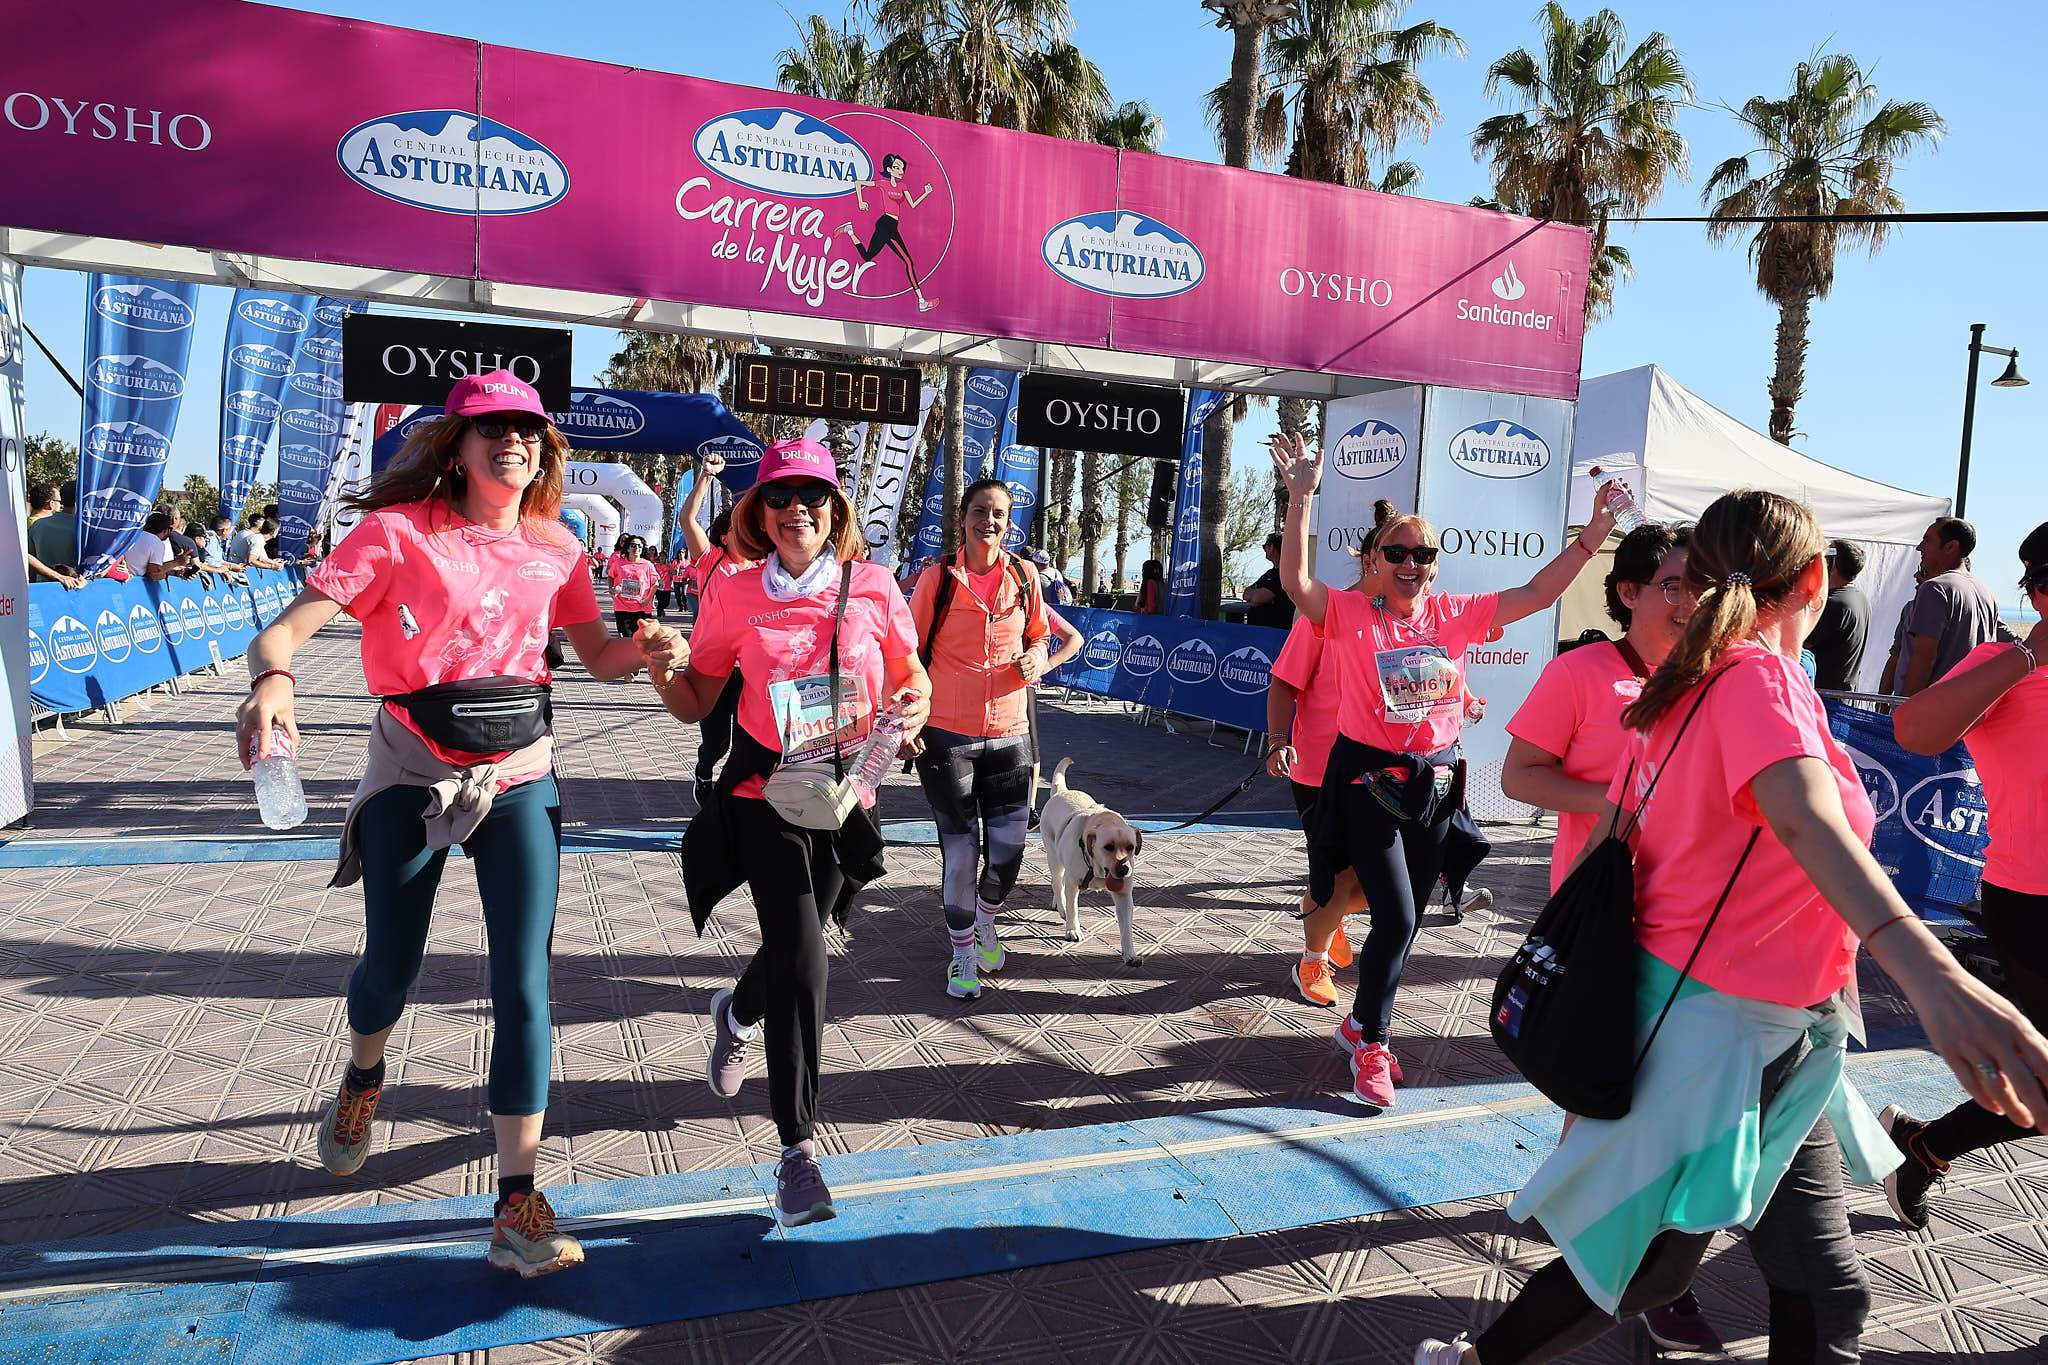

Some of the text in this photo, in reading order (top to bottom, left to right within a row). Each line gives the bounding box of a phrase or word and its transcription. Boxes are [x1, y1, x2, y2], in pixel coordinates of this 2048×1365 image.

[4, 91, 213, 152] OYSHO
[393, 138, 466, 157] CENTRAL
[707, 130, 858, 182] ASTURIANA
[737, 132, 856, 158] CENTRAL LECHERA
[356, 137, 552, 197] ASTURIANA
[676, 176, 825, 239] Carrera
[1054, 234, 1193, 282] ASTURIANA
[1081, 234, 1189, 257] CENTRAL LECHERA
[711, 229, 877, 307] de la Mujer
[1279, 267, 1393, 307] OYSHO
[98, 293, 186, 325] ASTURIANA
[243, 304, 303, 330] ASTURIANA
[1456, 298, 1554, 331] Santander
[235, 349, 292, 374] ASTURIANA
[382, 344, 541, 386] OYSHO
[94, 364, 178, 394] ASTURIANA
[484, 382, 529, 401] DRUNI
[571, 404, 594, 412] NTRAL
[1045, 398, 1161, 435] OYSHO
[285, 413, 334, 433] ASTURIANA
[88, 432, 166, 460] ASTURIANA
[781, 449, 820, 465] DRUNI
[1336, 445, 1401, 467] ASTURIANA
[1455, 438, 1543, 467] ASTURIANA
[1440, 528, 1545, 559] OYSHO
[433, 556, 480, 575] OYSHO
[748, 609, 791, 626] OYSHO
[1086, 643, 1119, 662] ASTURIANA
[1124, 650, 1160, 668] ASTURIANA
[1169, 654, 1212, 675] ASTURIANA
[1467, 647, 1529, 665] ntander
[1221, 661, 1269, 686] ASTURIANA
[1408, 678, 1438, 693] 016
[800, 688, 830, 702] TURIANA
[802, 715, 835, 737] 016
[842, 736, 864, 748] VALENCIA
